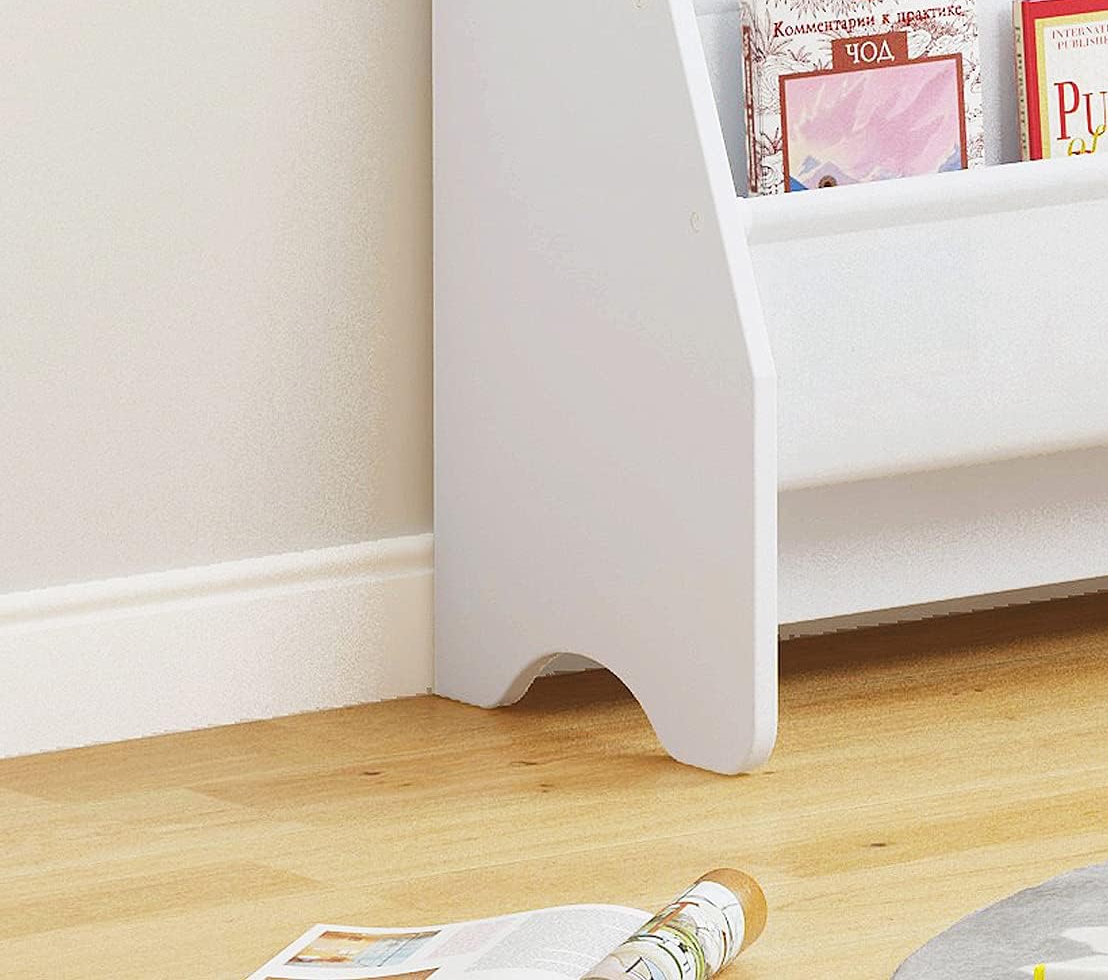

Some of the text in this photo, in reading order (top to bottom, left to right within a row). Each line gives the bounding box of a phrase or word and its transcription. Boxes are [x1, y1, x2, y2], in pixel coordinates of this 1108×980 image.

[773, 16, 875, 38] Комментарии
[882, 14, 890, 24] к
[845, 40, 894, 64] ЧОД
[1068, 124, 1106, 156] of
